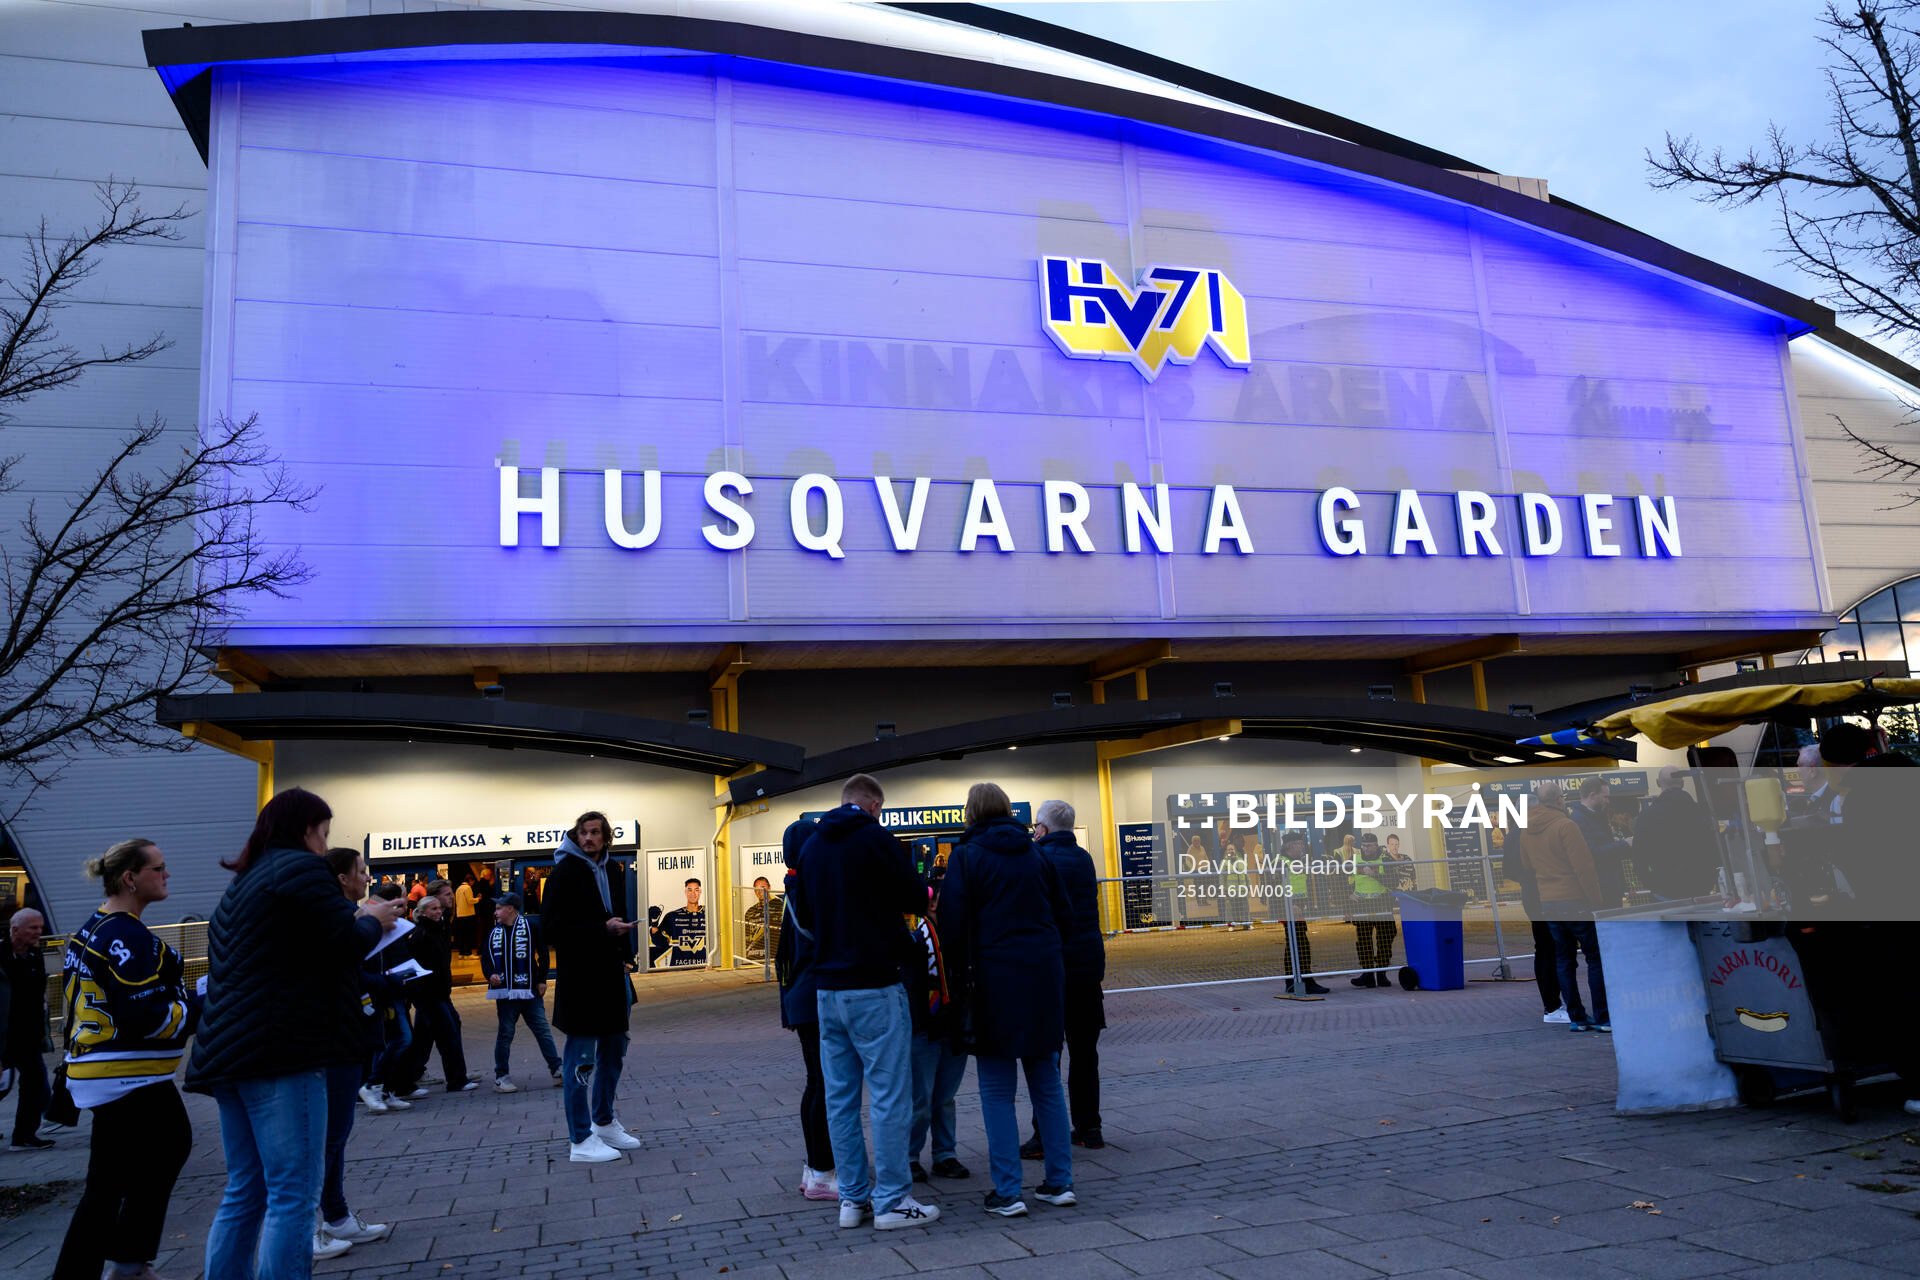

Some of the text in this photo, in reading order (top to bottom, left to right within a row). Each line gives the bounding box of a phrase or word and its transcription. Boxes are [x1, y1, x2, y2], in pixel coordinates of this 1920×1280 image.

[1042, 256, 1228, 355] HV71
[1232, 364, 1492, 430] ARENA
[499, 466, 1683, 560] HUSQVARNA GARDEN
[879, 804, 967, 827] UBLIKENTR
[382, 834, 487, 851] BILJETTKASSA
[753, 852, 772, 865] HEJA
[658, 855, 695, 870] HEJA HV!
[1710, 949, 1802, 991] VARM KORV
